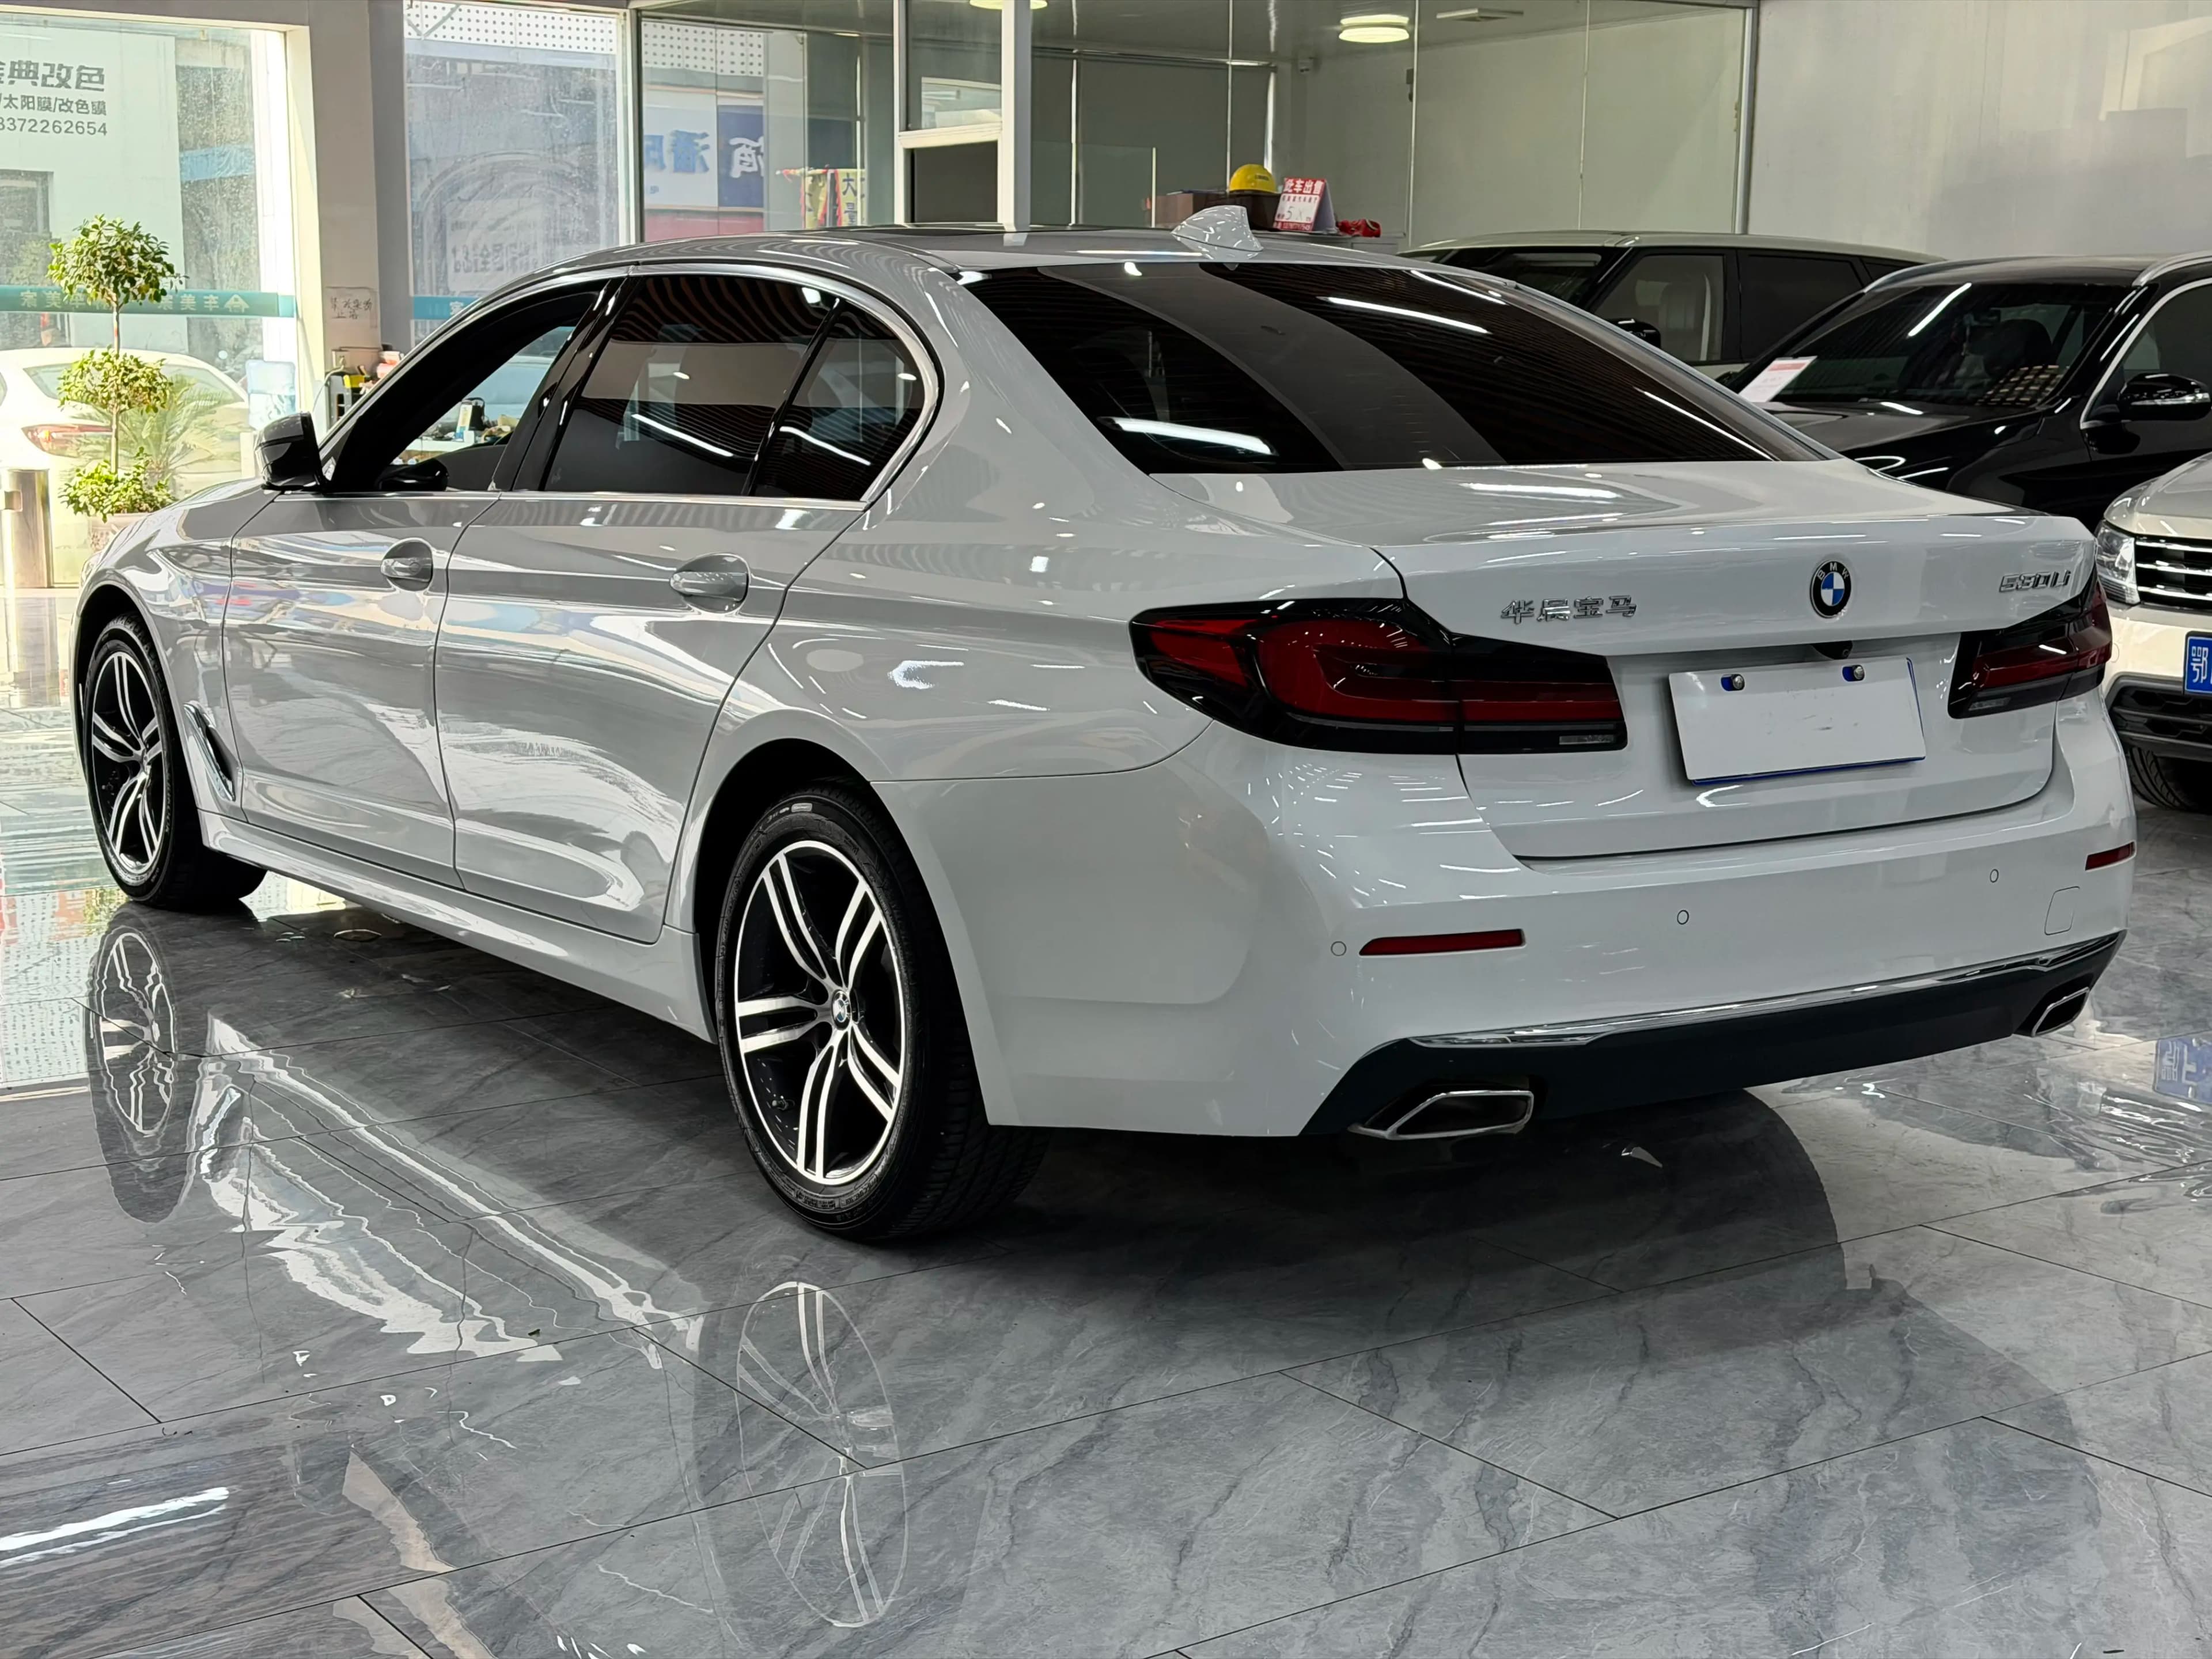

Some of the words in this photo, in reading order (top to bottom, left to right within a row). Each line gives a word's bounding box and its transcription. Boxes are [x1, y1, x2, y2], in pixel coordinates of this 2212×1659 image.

[0, 60, 105, 92] 典改色
[1817, 562, 1850, 581] BMW
[1501, 595, 1637, 624] 华晨宝马
[2190, 645, 2212, 684] 鄂
